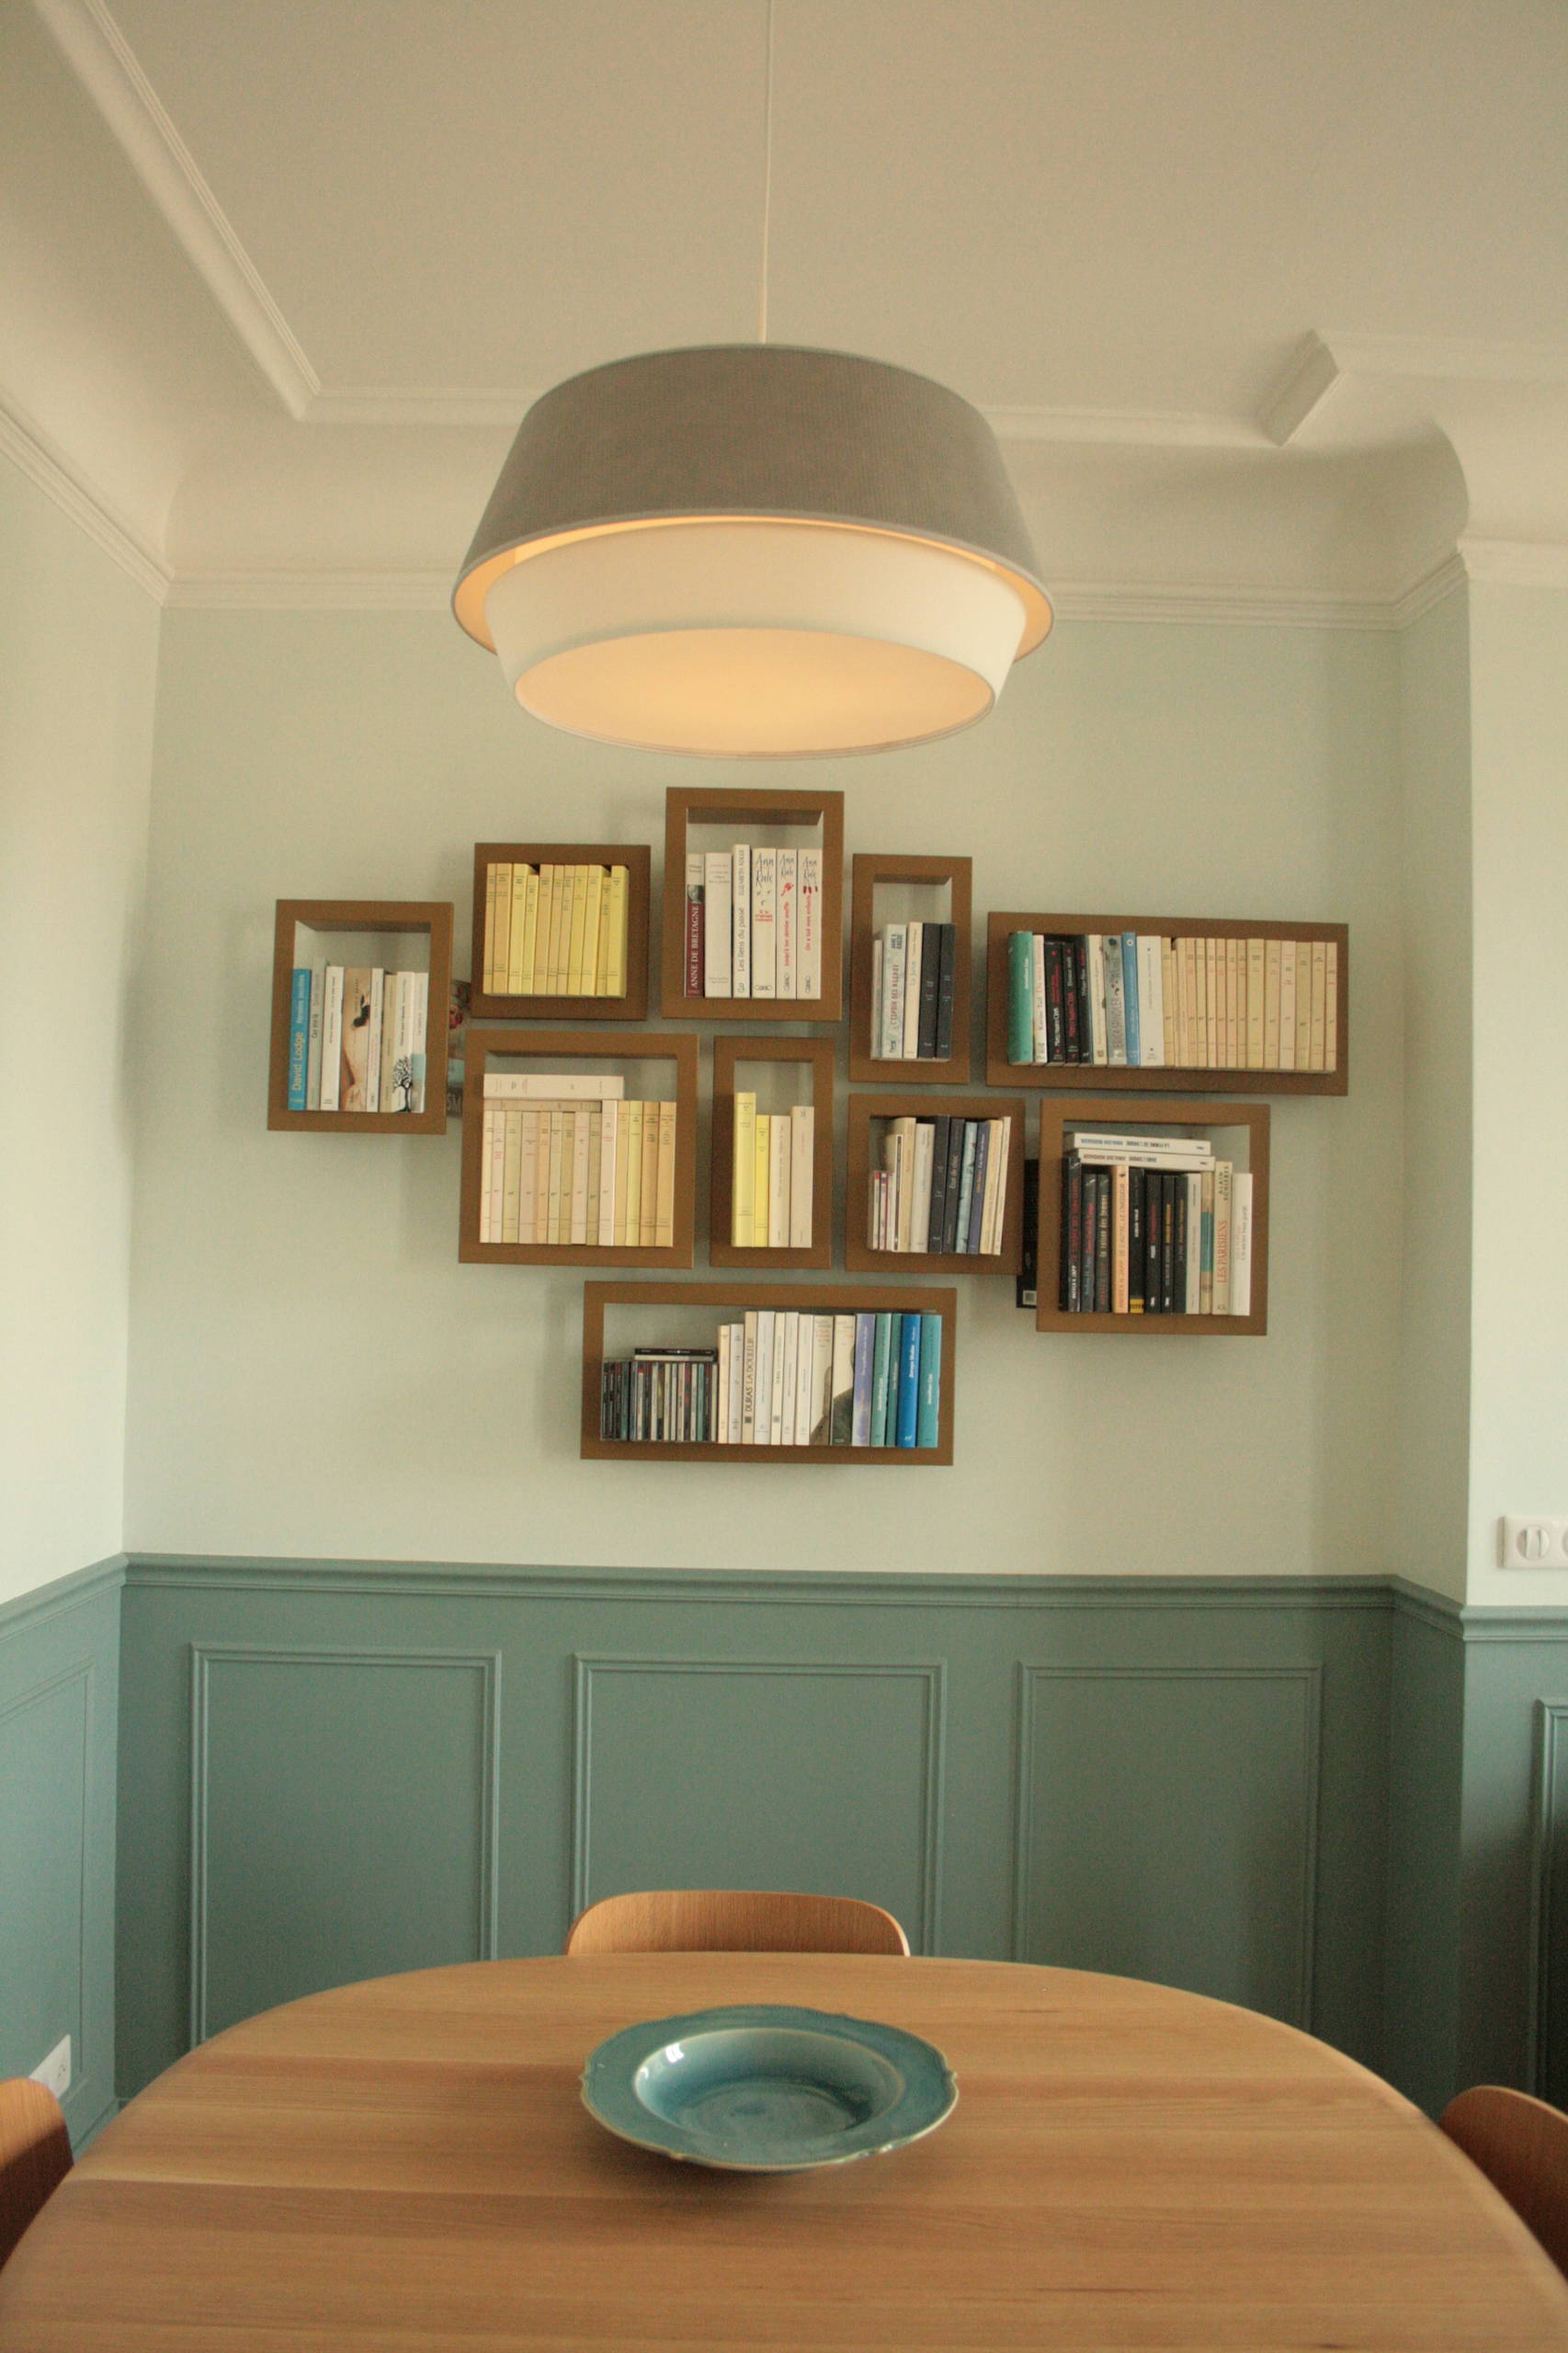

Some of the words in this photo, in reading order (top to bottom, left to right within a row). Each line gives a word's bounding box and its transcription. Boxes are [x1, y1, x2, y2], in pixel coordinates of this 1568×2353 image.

[691, 904, 699, 949] BRETAGNE
[691, 950, 699, 963] DE
[690, 962, 699, 988] ANNE
[295, 1031, 306, 1061] Lodge
[292, 1063, 302, 1091] David
[1217, 1220, 1228, 1265] PARISIENS
[1216, 1267, 1227, 1283] LES
[745, 1374, 753, 1384] LA
[744, 1387, 753, 1412] DURAS
